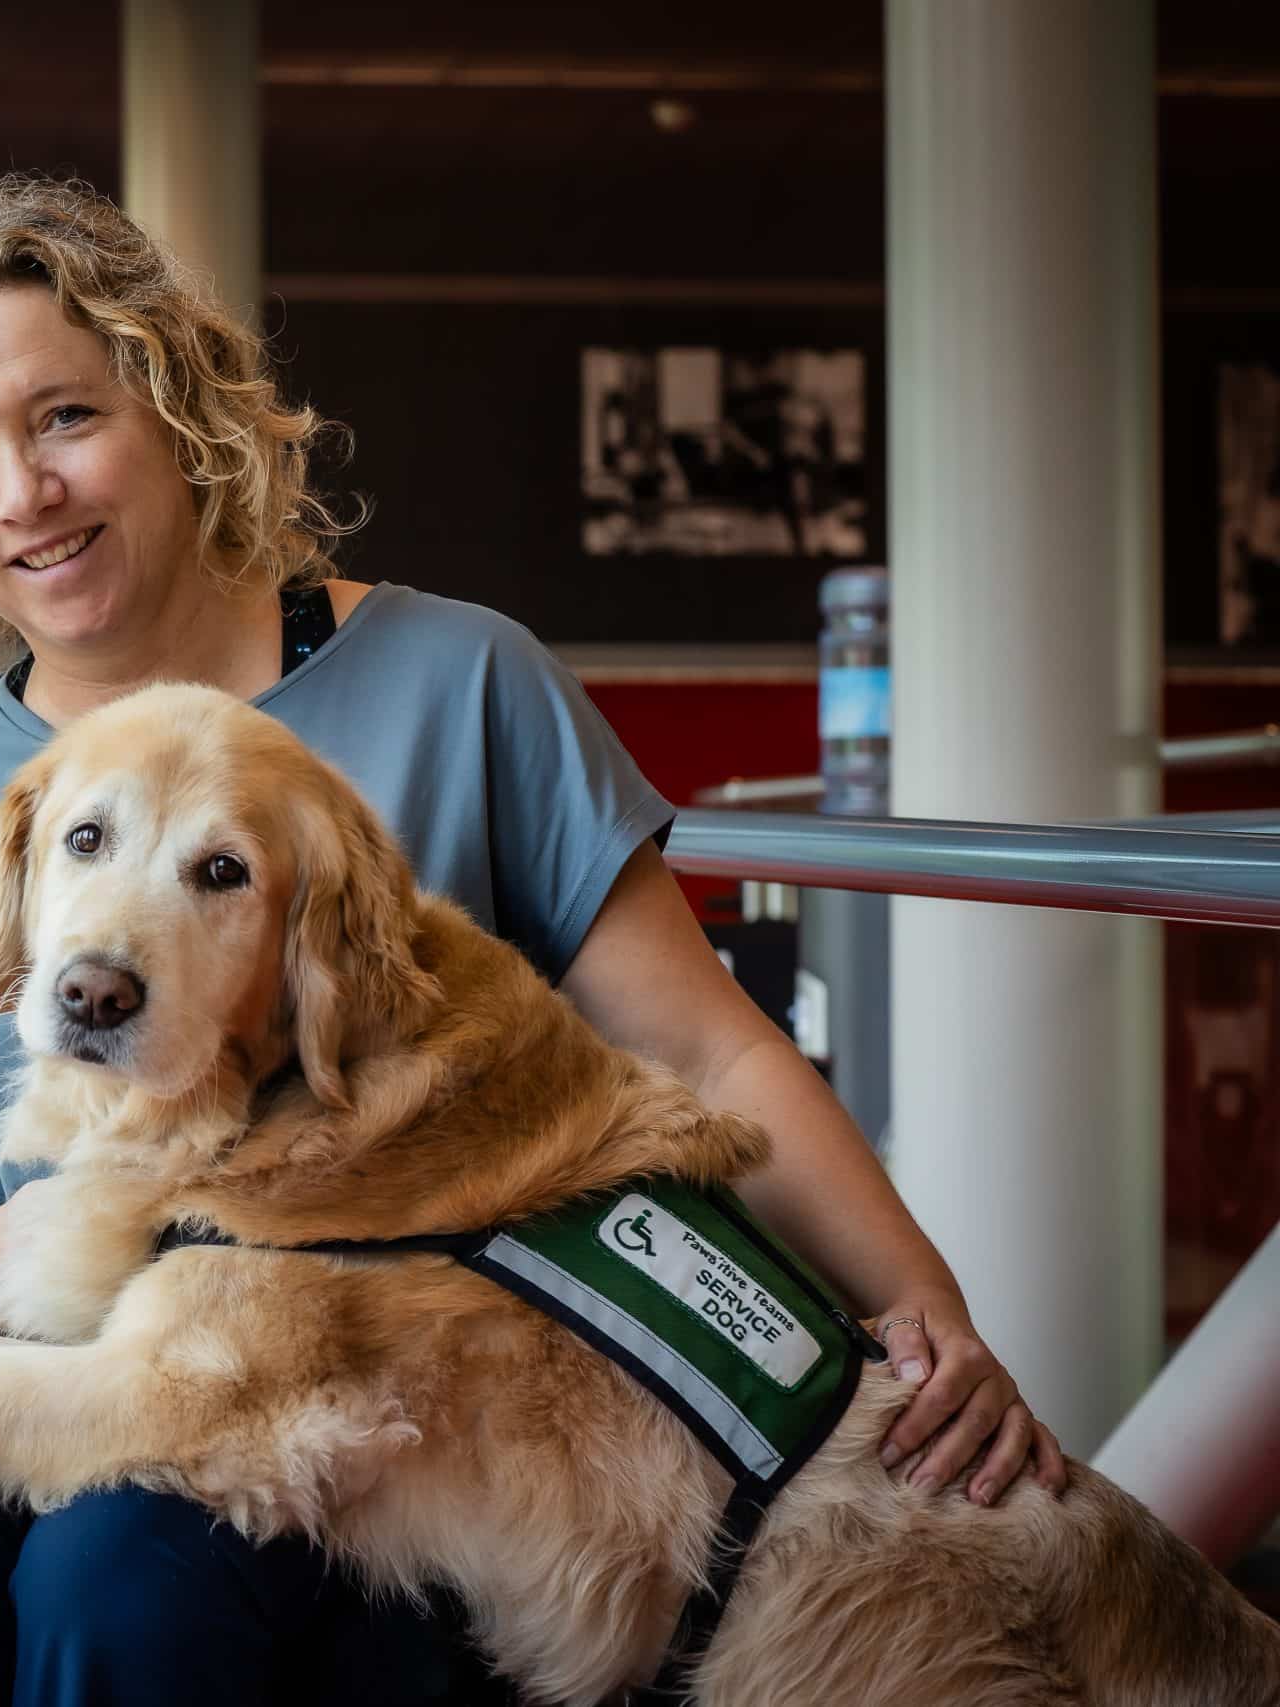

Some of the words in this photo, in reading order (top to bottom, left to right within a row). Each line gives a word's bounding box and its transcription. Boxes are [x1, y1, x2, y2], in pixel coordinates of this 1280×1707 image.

[696, 1269, 782, 1344] SERVICE
[701, 1299, 747, 1342] DOG
[753, 1288, 795, 1332] Teams
